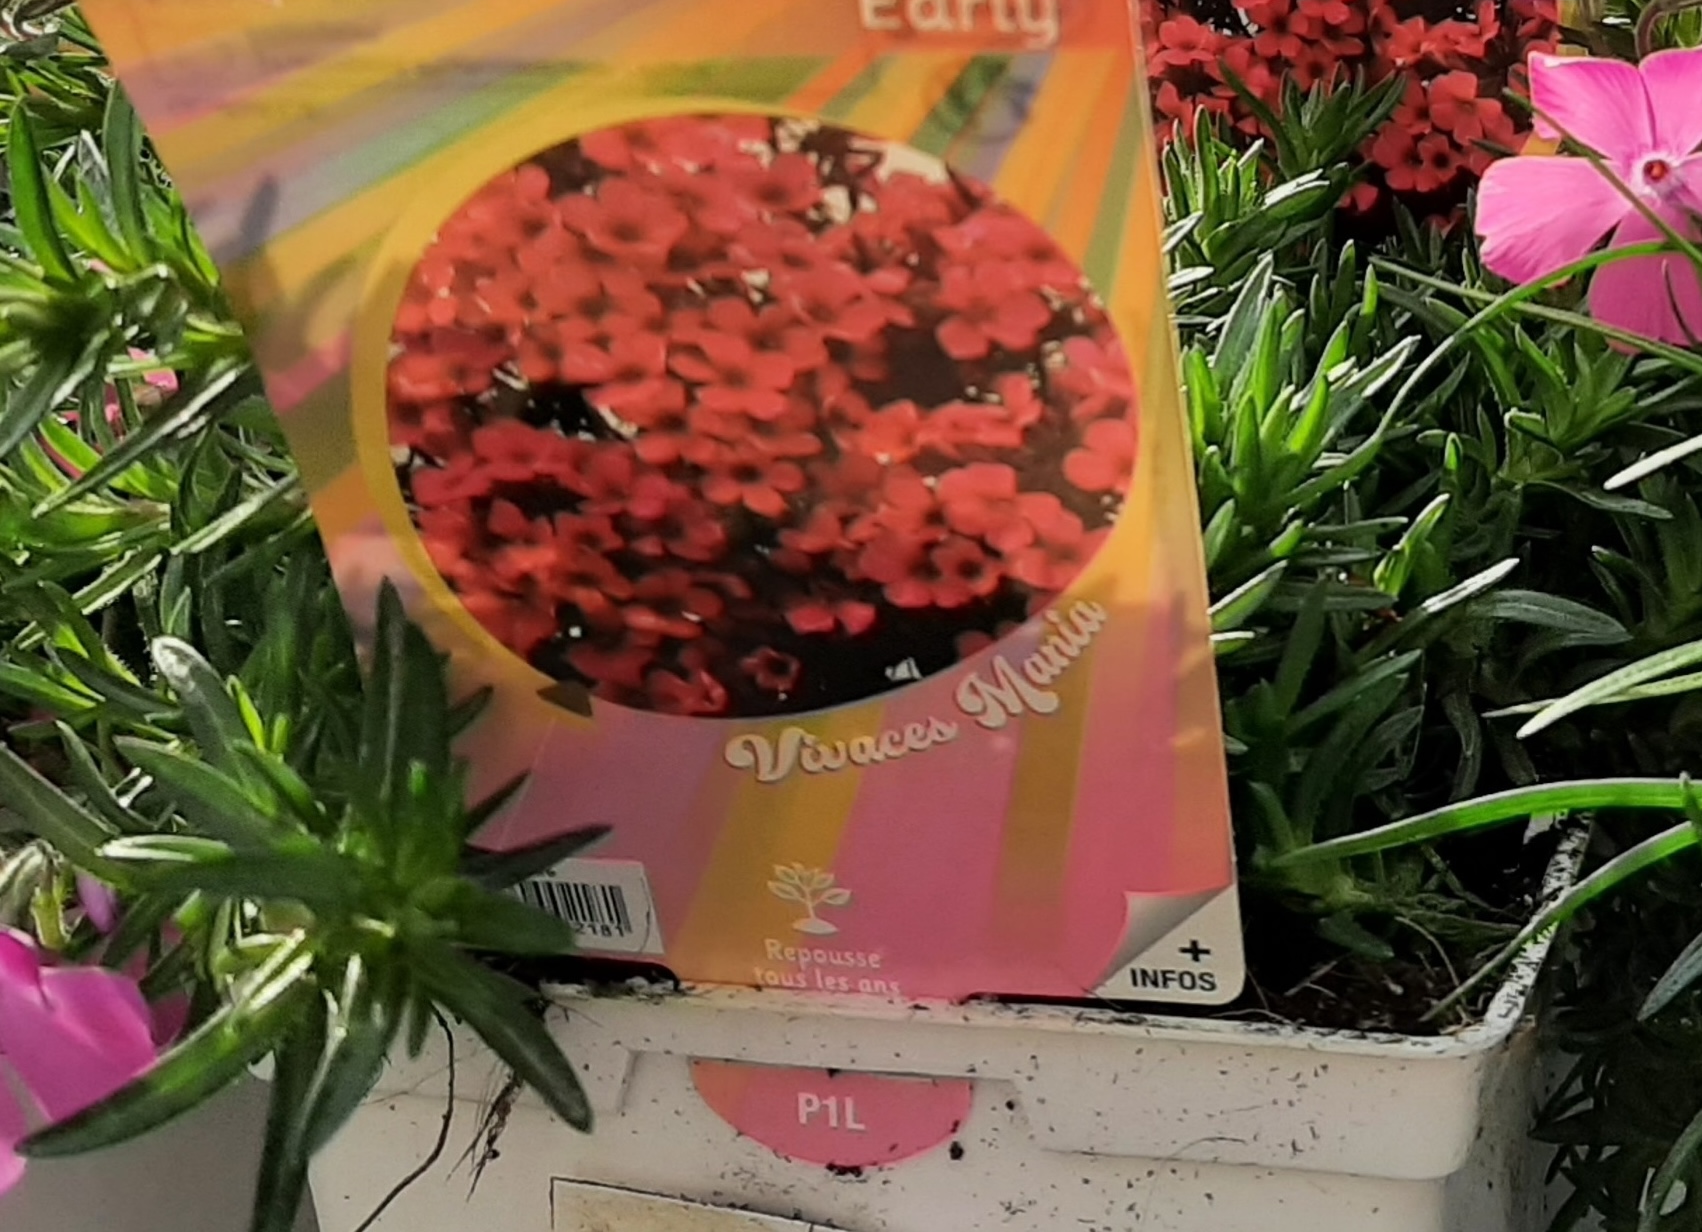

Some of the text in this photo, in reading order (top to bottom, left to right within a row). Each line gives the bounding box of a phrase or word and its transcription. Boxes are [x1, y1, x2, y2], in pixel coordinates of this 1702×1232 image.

[725, 601, 1106, 782] Vivaces Mania
[764, 938, 881, 970] Repousse
[754, 967, 900, 997] tous les ans
[1131, 968, 1217, 992] INFOS
[798, 1093, 866, 1130] P1L
